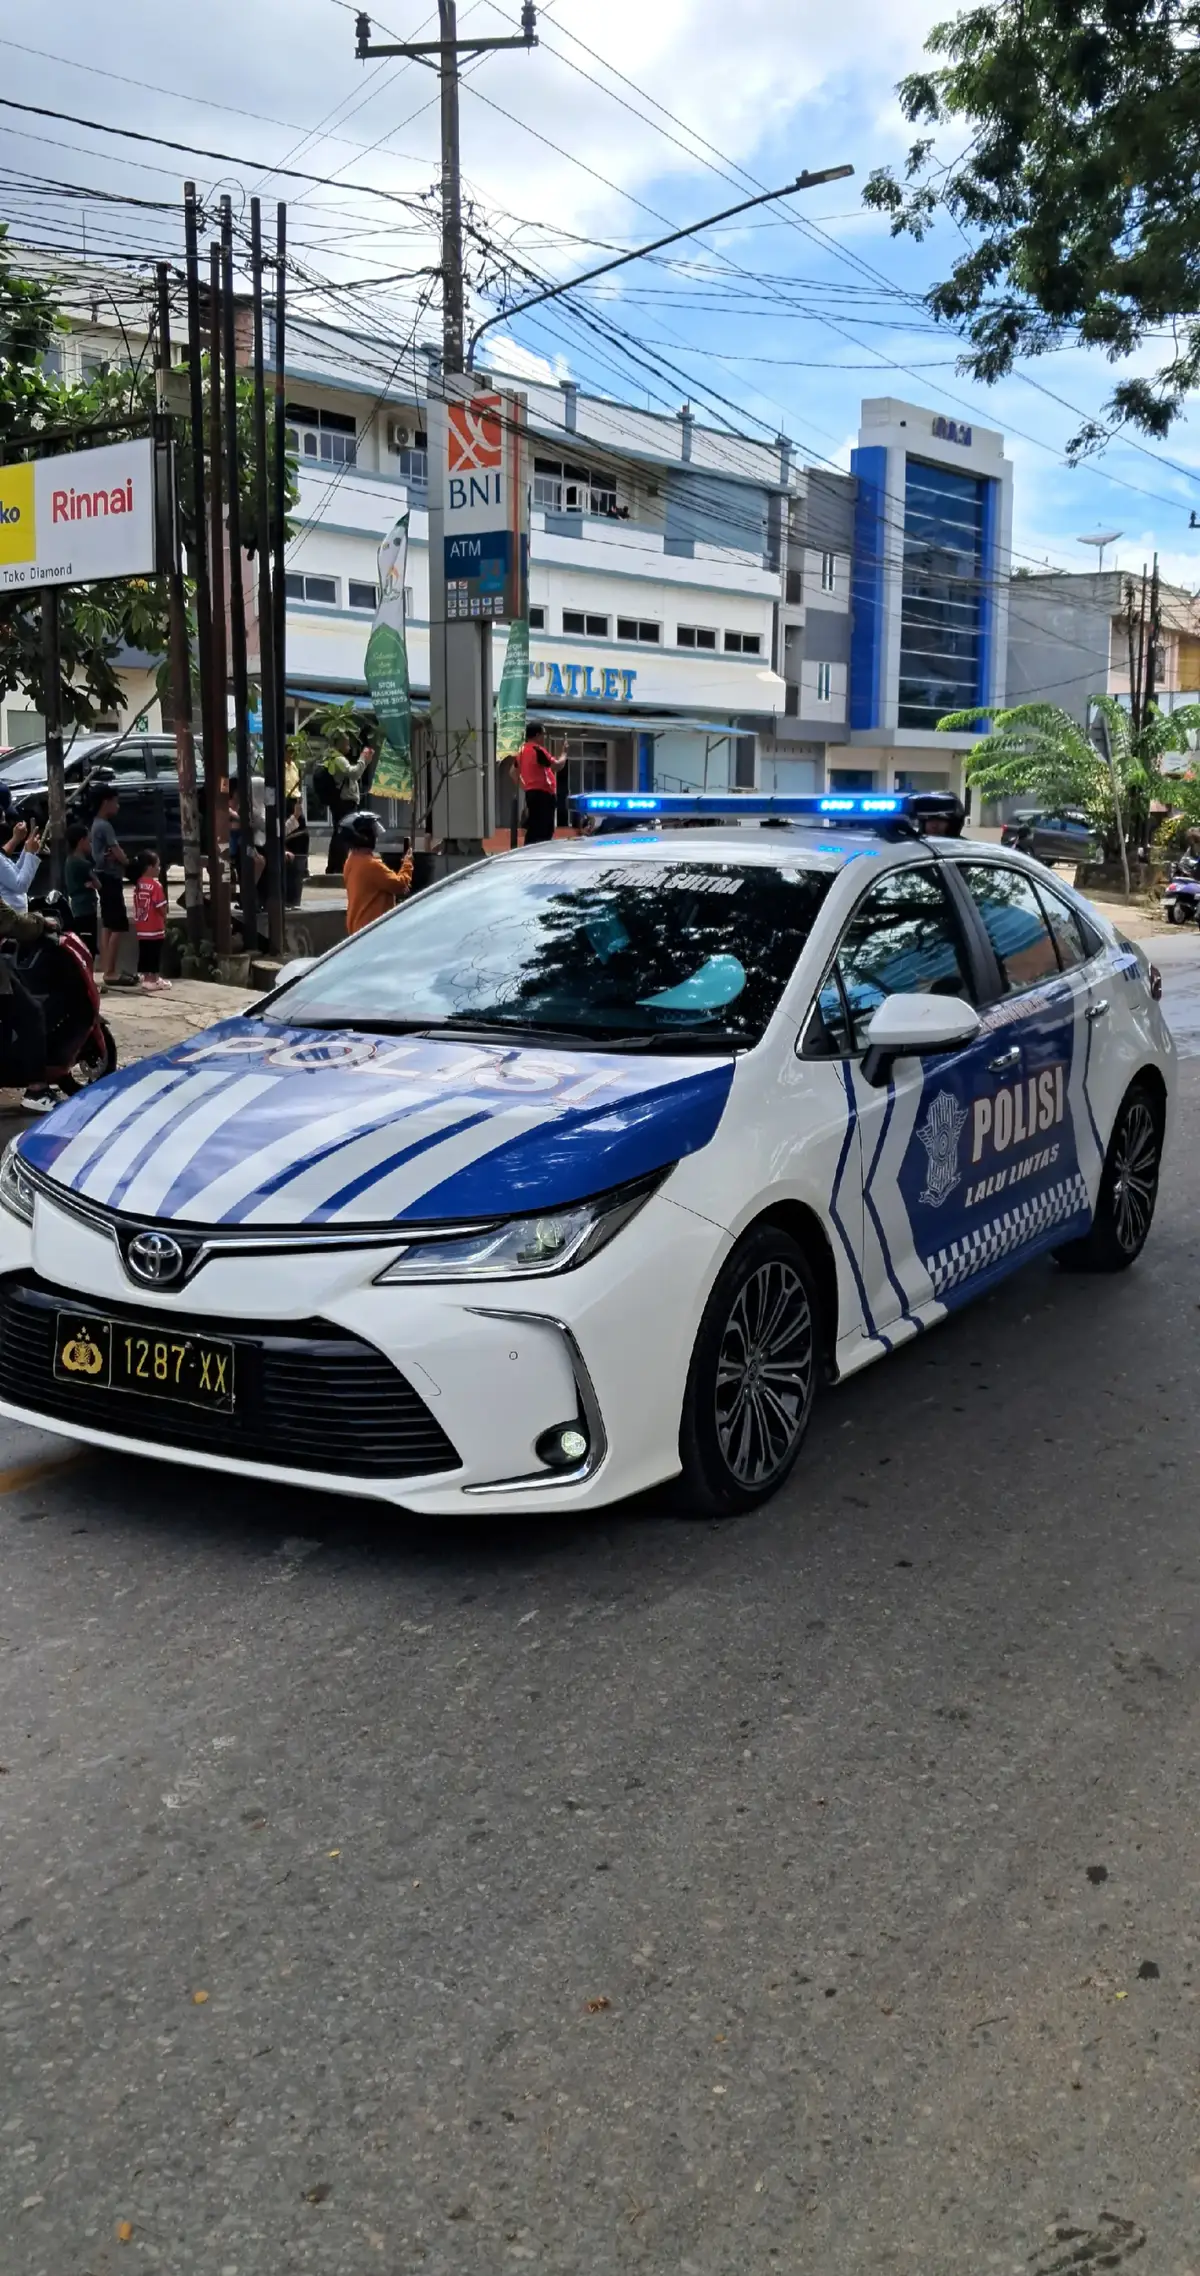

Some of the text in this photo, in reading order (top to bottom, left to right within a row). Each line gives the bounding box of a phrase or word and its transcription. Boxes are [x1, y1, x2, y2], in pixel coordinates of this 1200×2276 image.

[52, 478, 133, 523] Rinnai
[449, 473, 502, 510] BNI
[450, 539, 481, 558] ATM
[3, 562, 72, 583] Toko Diamond
[546, 662, 637, 700] ATLET
[664, 873, 745, 895] SULTRA
[173, 1036, 627, 1103] POLISI
[972, 1066, 1064, 1163] POLISI
[964, 1143, 1060, 1208] LALU LINTAS
[124, 1337, 228, 1394] 1287 XX
